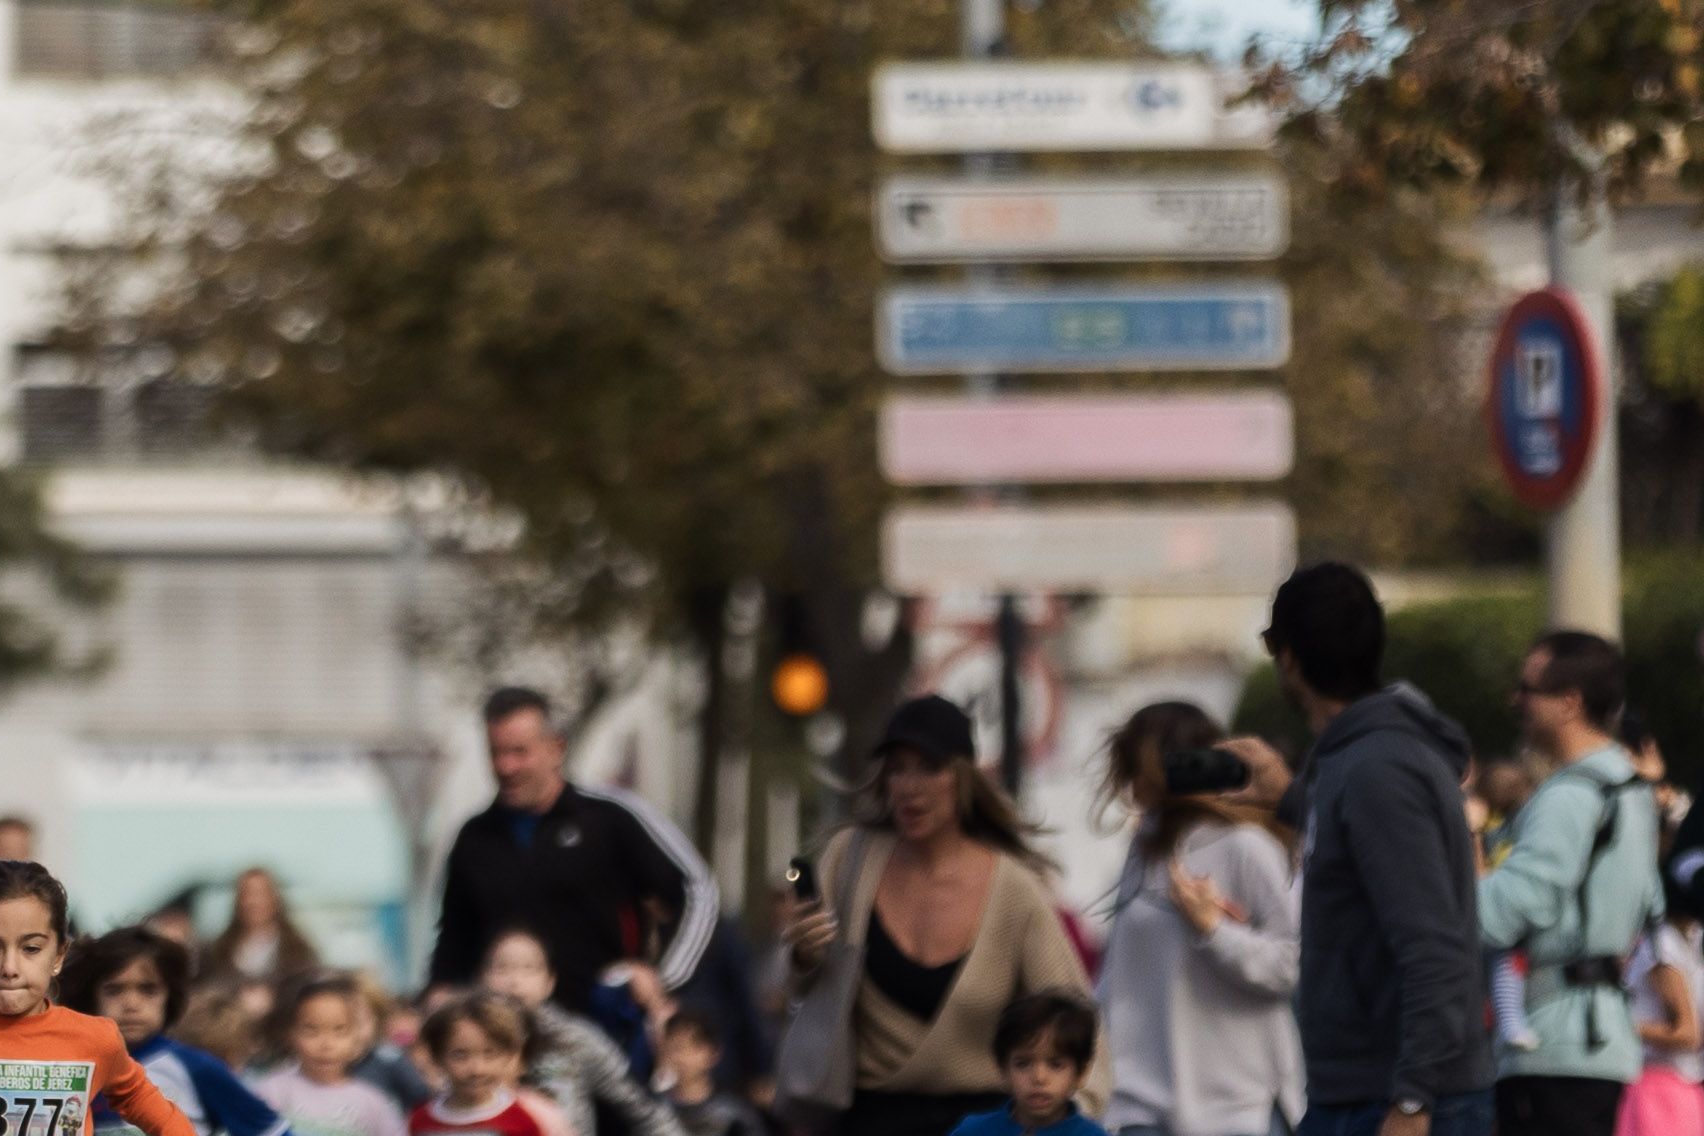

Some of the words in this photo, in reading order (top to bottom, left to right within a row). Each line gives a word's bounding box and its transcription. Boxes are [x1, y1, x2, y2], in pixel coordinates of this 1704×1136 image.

[4, 1064, 48, 1078] INFANTIL
[32, 1077, 46, 1090] DE
[47, 1077, 73, 1091] JEREZ
